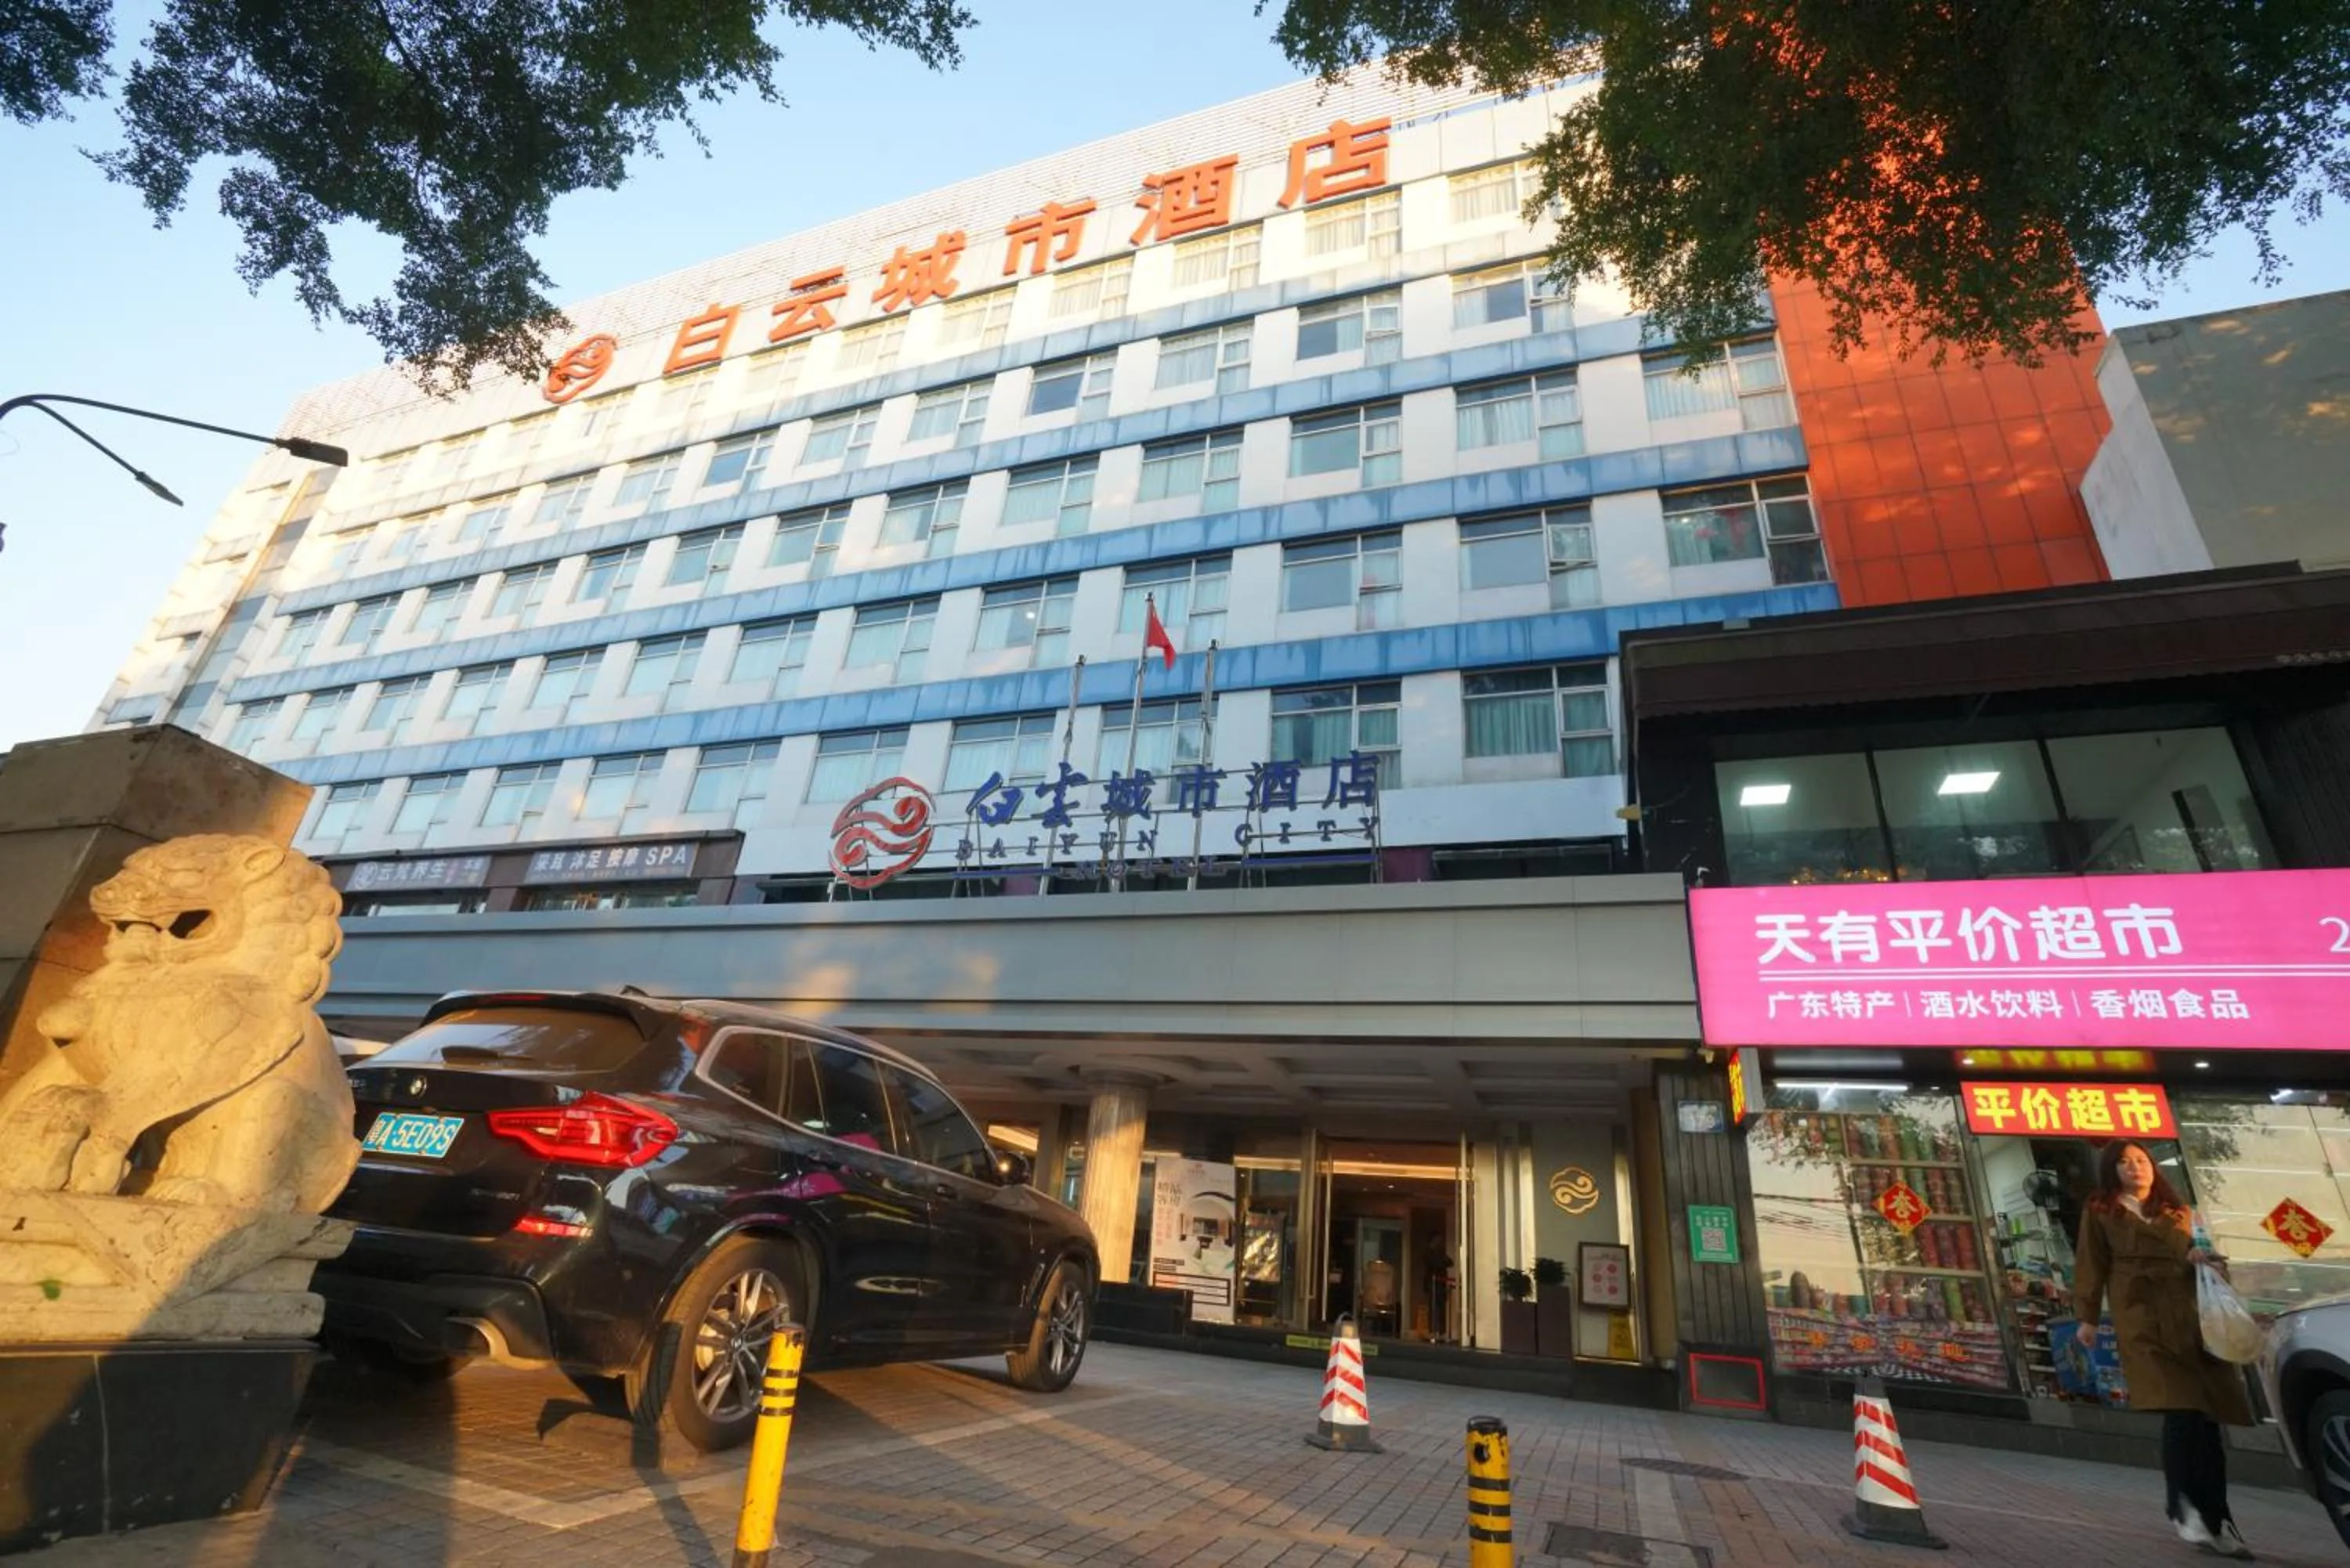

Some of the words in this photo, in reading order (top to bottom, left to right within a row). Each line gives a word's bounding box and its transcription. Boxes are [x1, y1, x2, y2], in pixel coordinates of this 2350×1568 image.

[663, 117, 1391, 374] 白云城市酒店
[966, 750, 1379, 828] 白云城市酒店
[606, 847, 640, 869] 按摩
[645, 844, 686, 866] SPA
[956, 829, 1158, 860] BAIYUN
[1235, 817, 1379, 847] CITY
[1755, 903, 2182, 964] 天有平价超市
[1767, 990, 1895, 1020] 广东特产
[1920, 990, 2063, 1020] 酒水饮料
[2090, 988, 2251, 1020] 香烟食品
[1972, 1087, 2163, 1133] 平价超市
